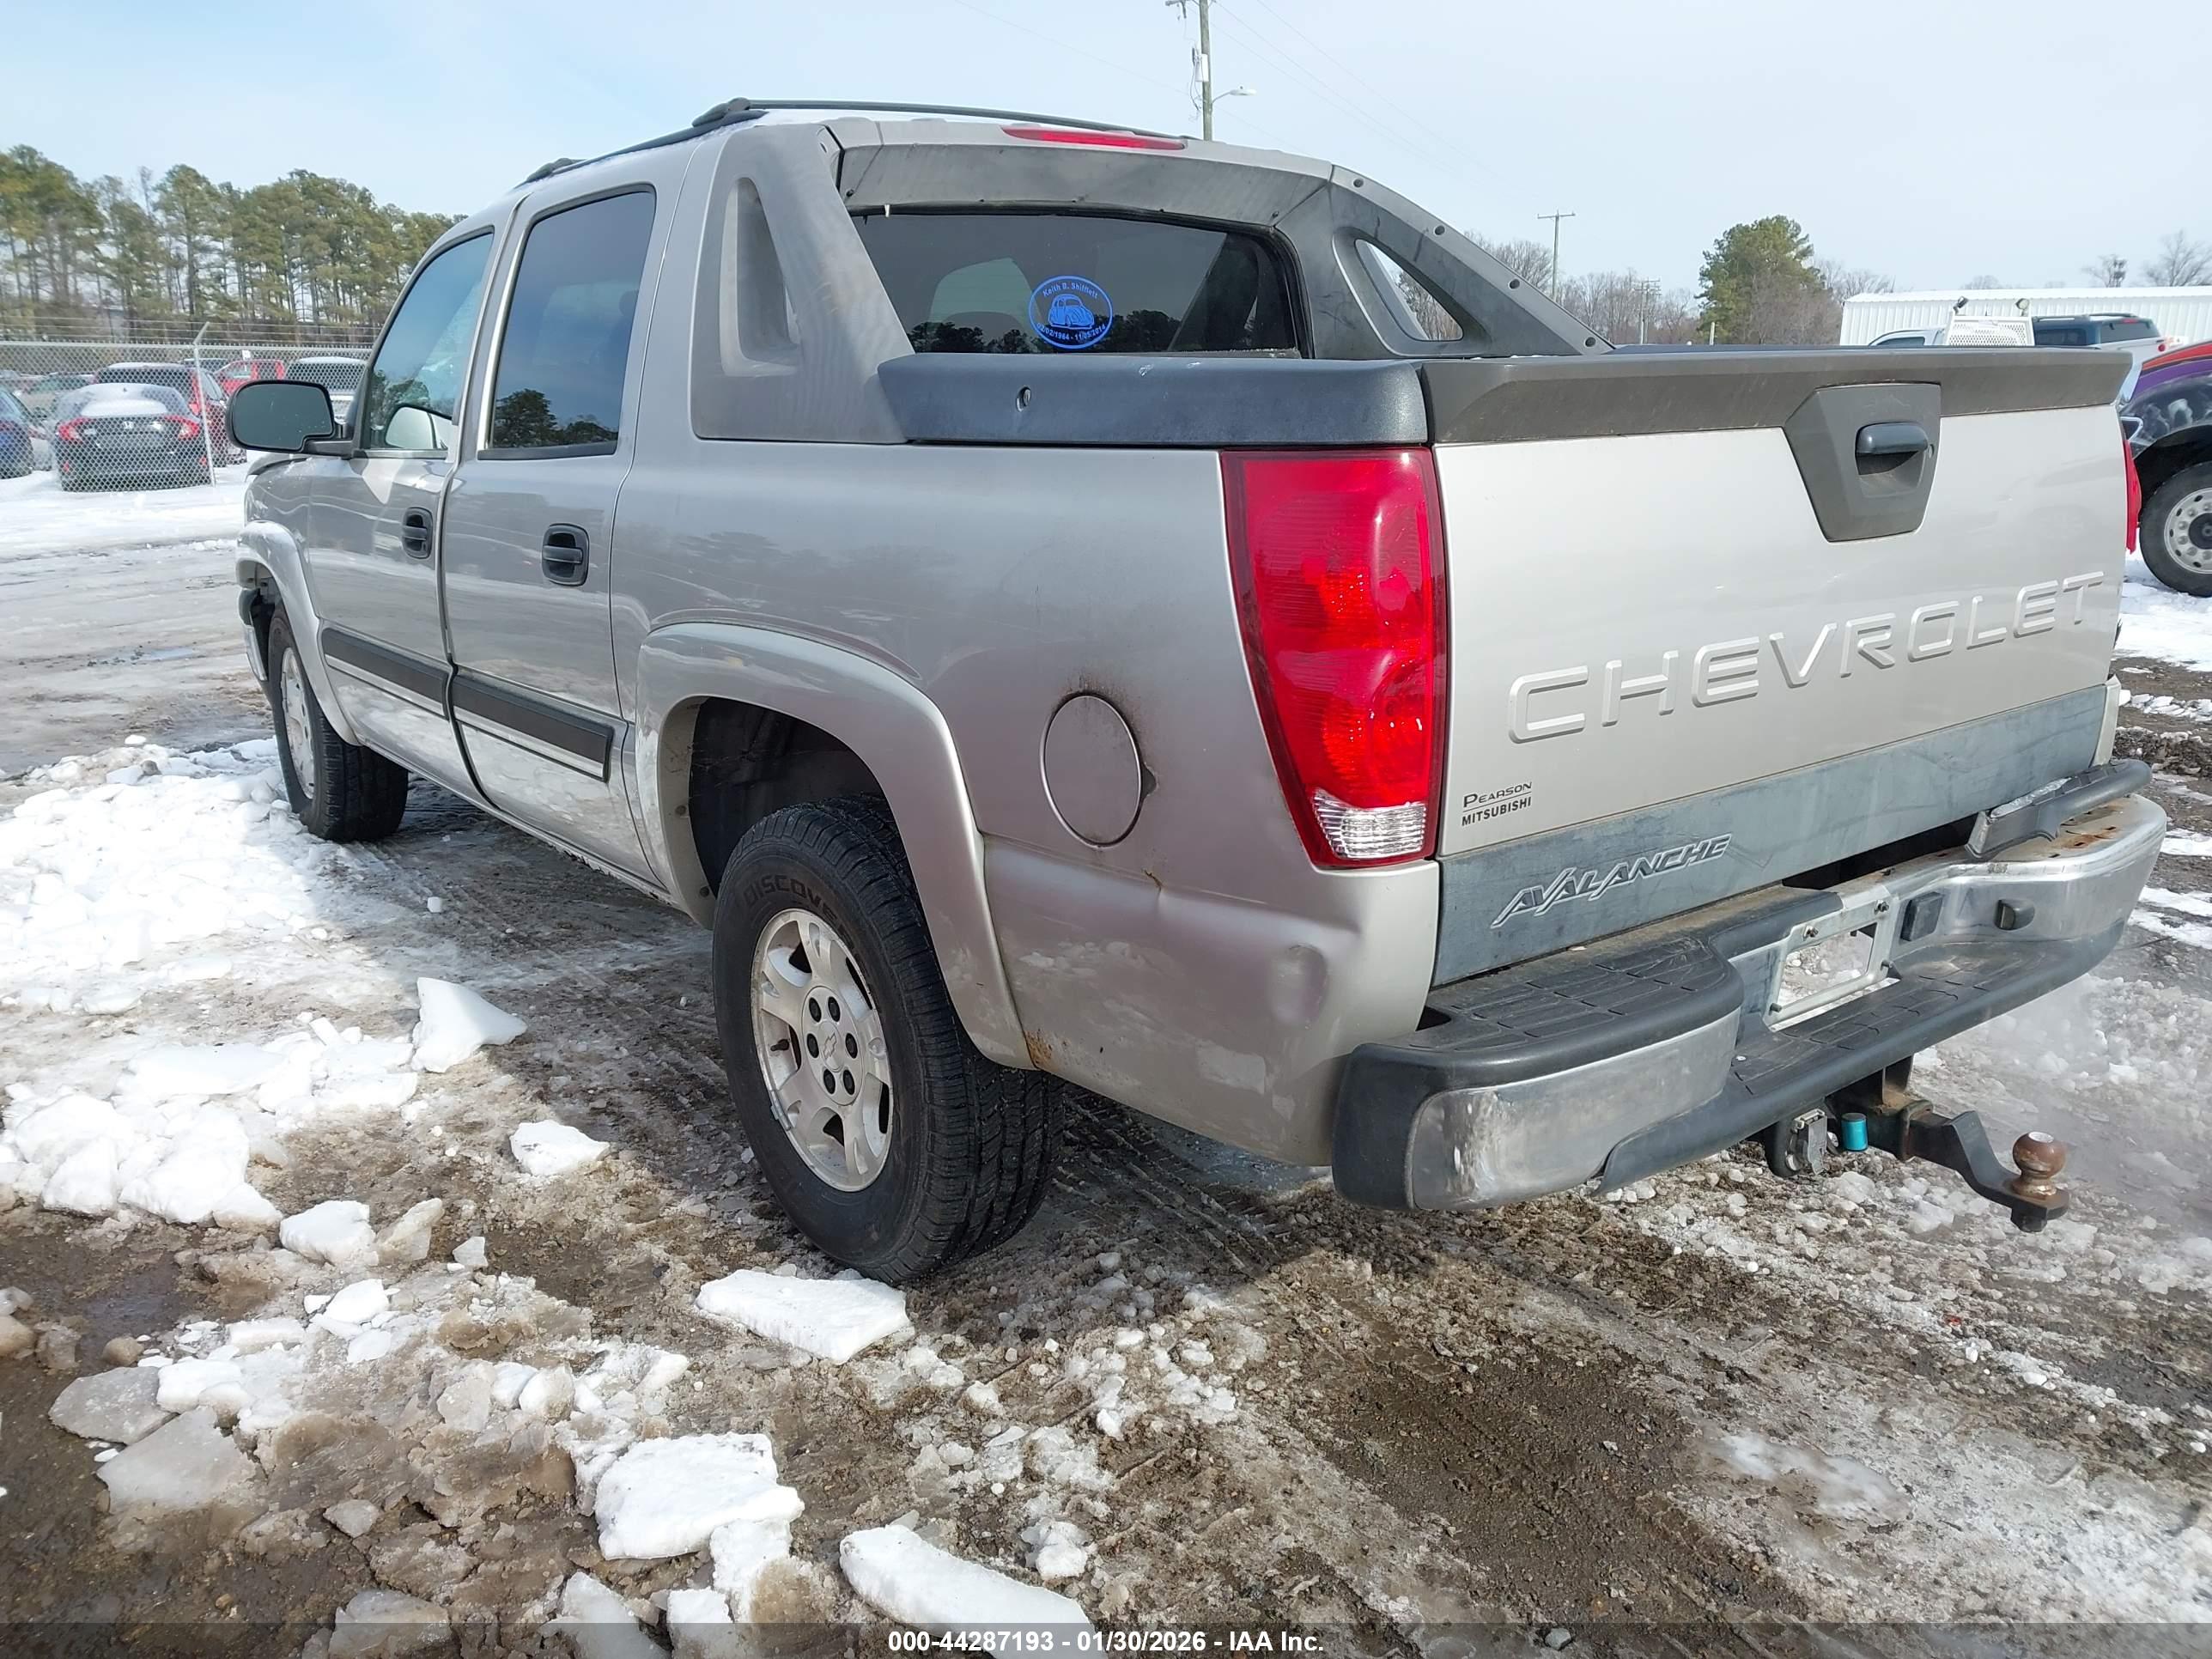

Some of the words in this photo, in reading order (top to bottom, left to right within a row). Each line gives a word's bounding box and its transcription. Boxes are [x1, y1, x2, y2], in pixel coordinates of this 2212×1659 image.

[1042, 283, 1060, 298] Keith
[1508, 570, 2105, 744] CHEVROLET
[1462, 796, 1531, 826] MITSUBISHI
[1490, 832, 1733, 928] AVALANCHE
